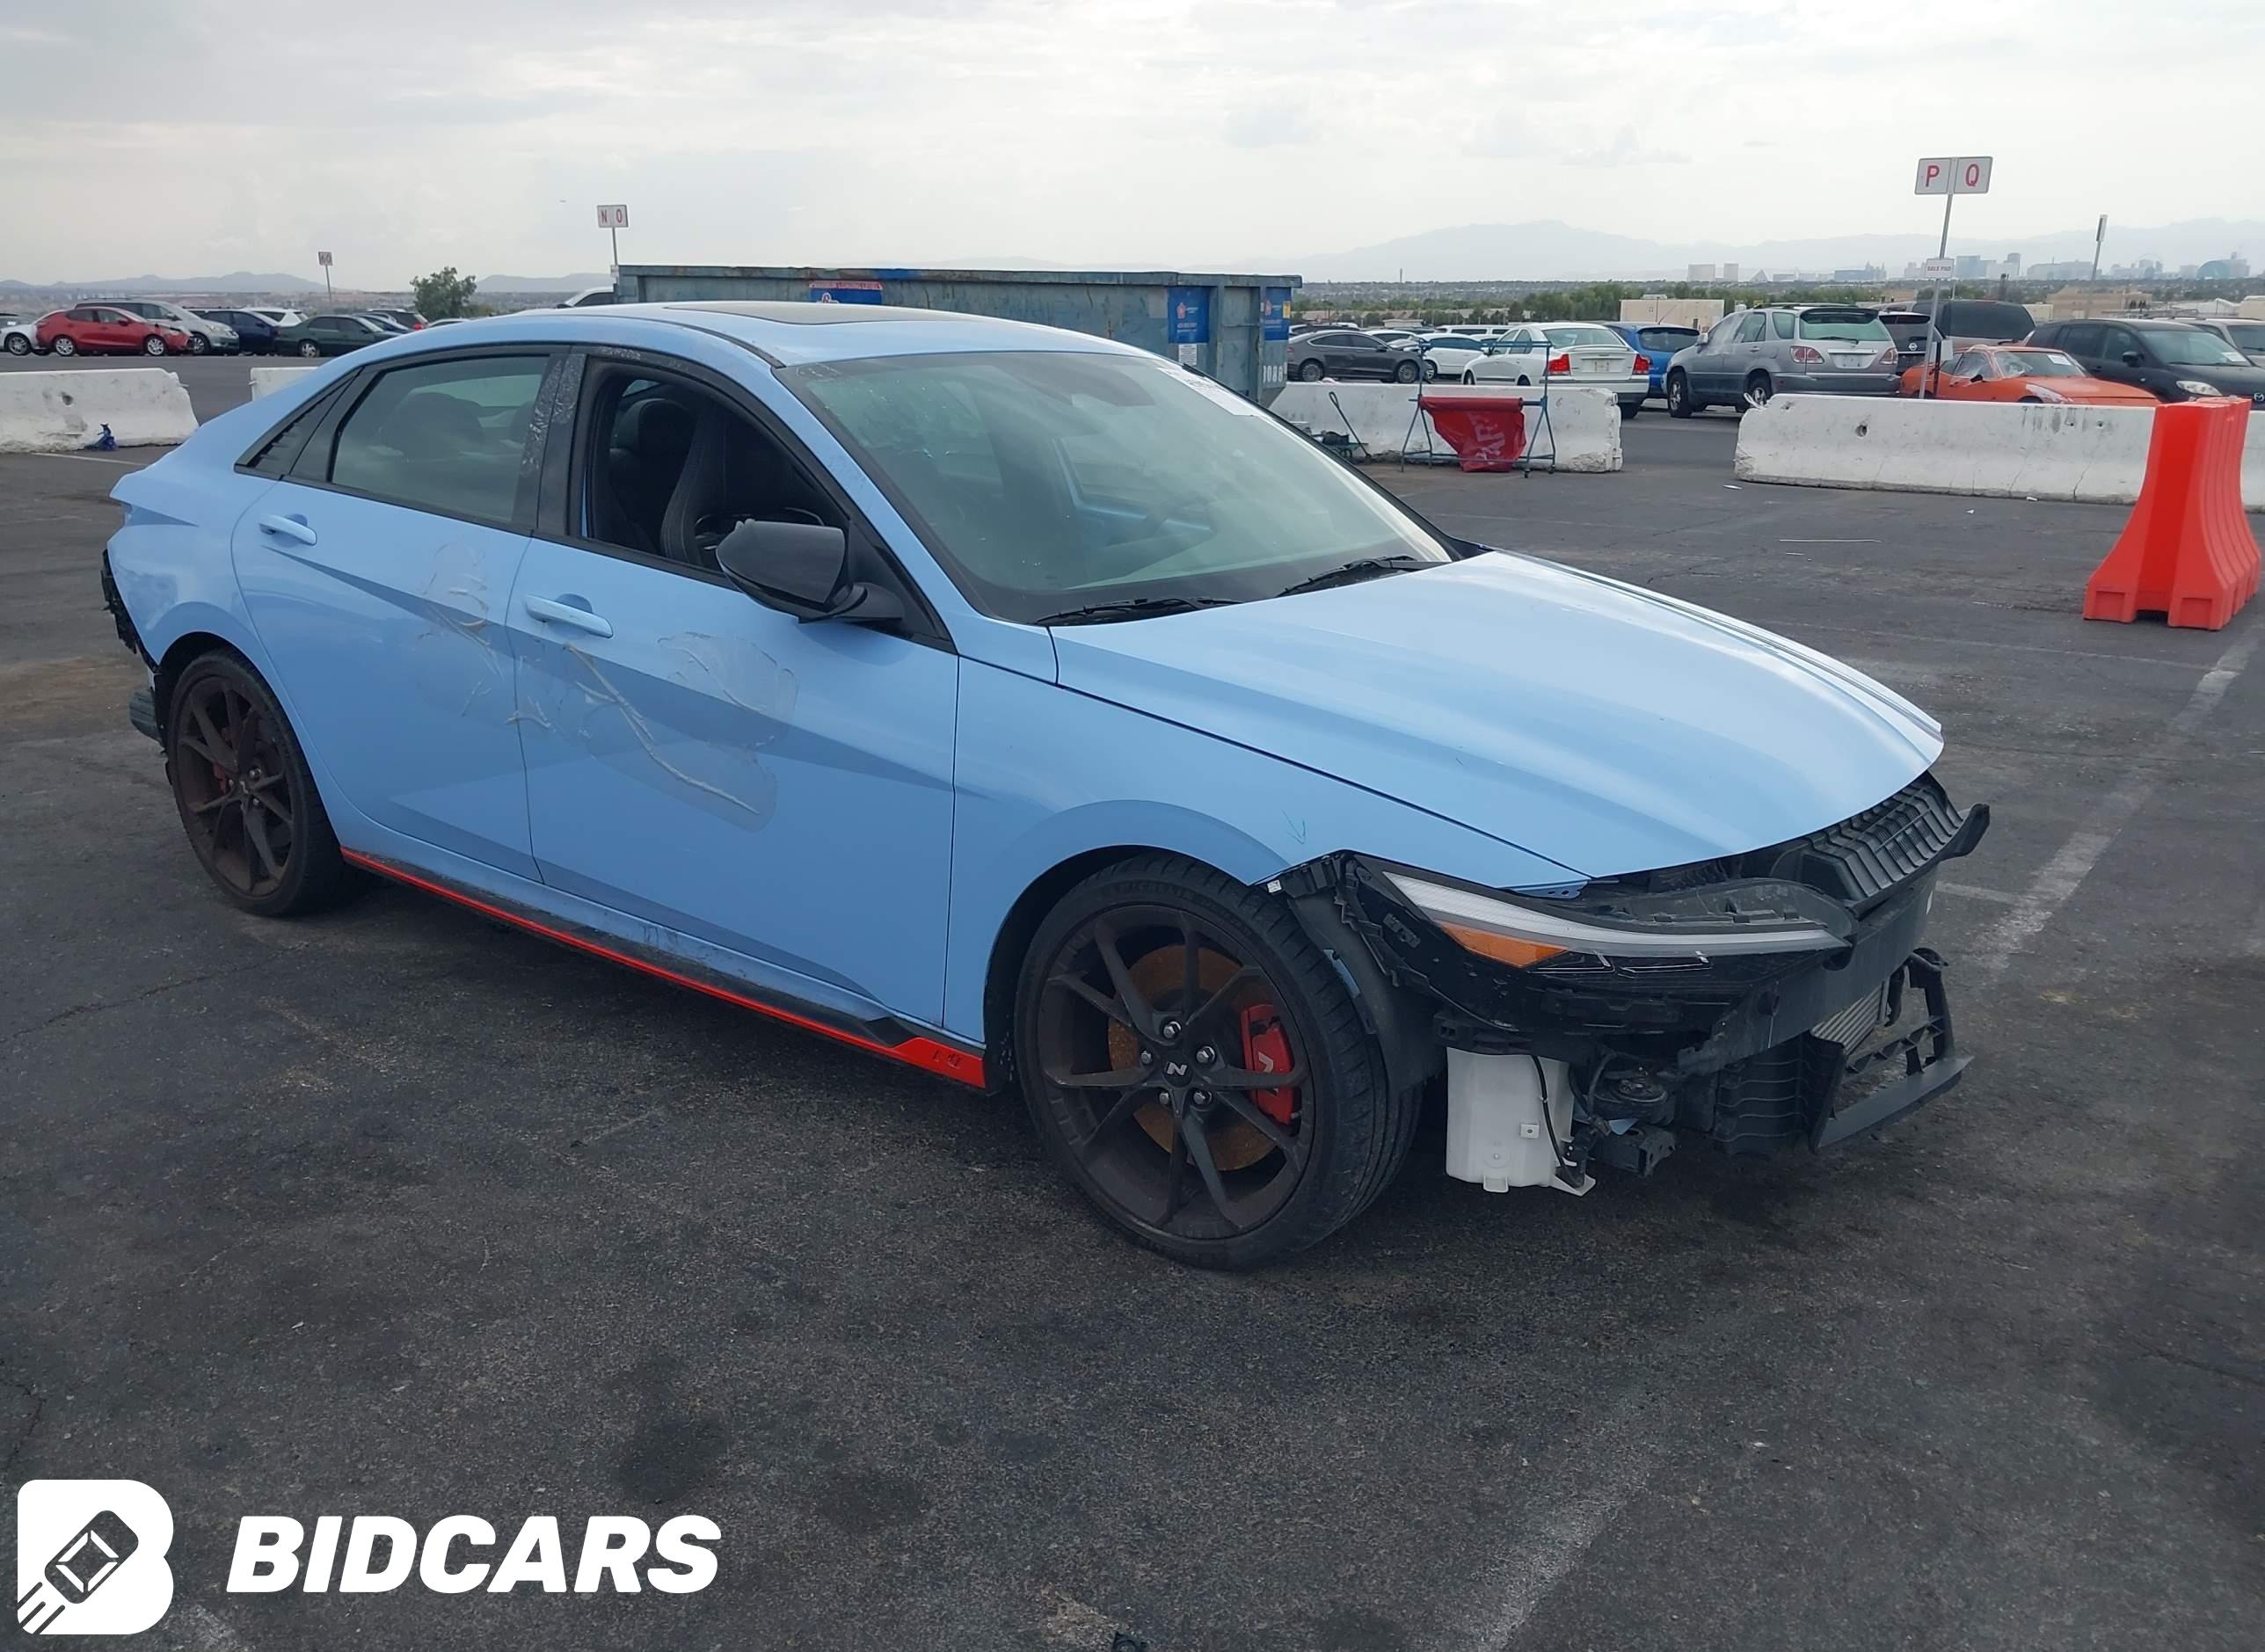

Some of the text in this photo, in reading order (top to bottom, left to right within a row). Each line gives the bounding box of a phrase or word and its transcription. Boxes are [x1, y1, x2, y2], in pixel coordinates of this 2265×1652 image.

[1926, 164, 1979, 187] P Q
[1166, 1061, 1188, 1076] N
